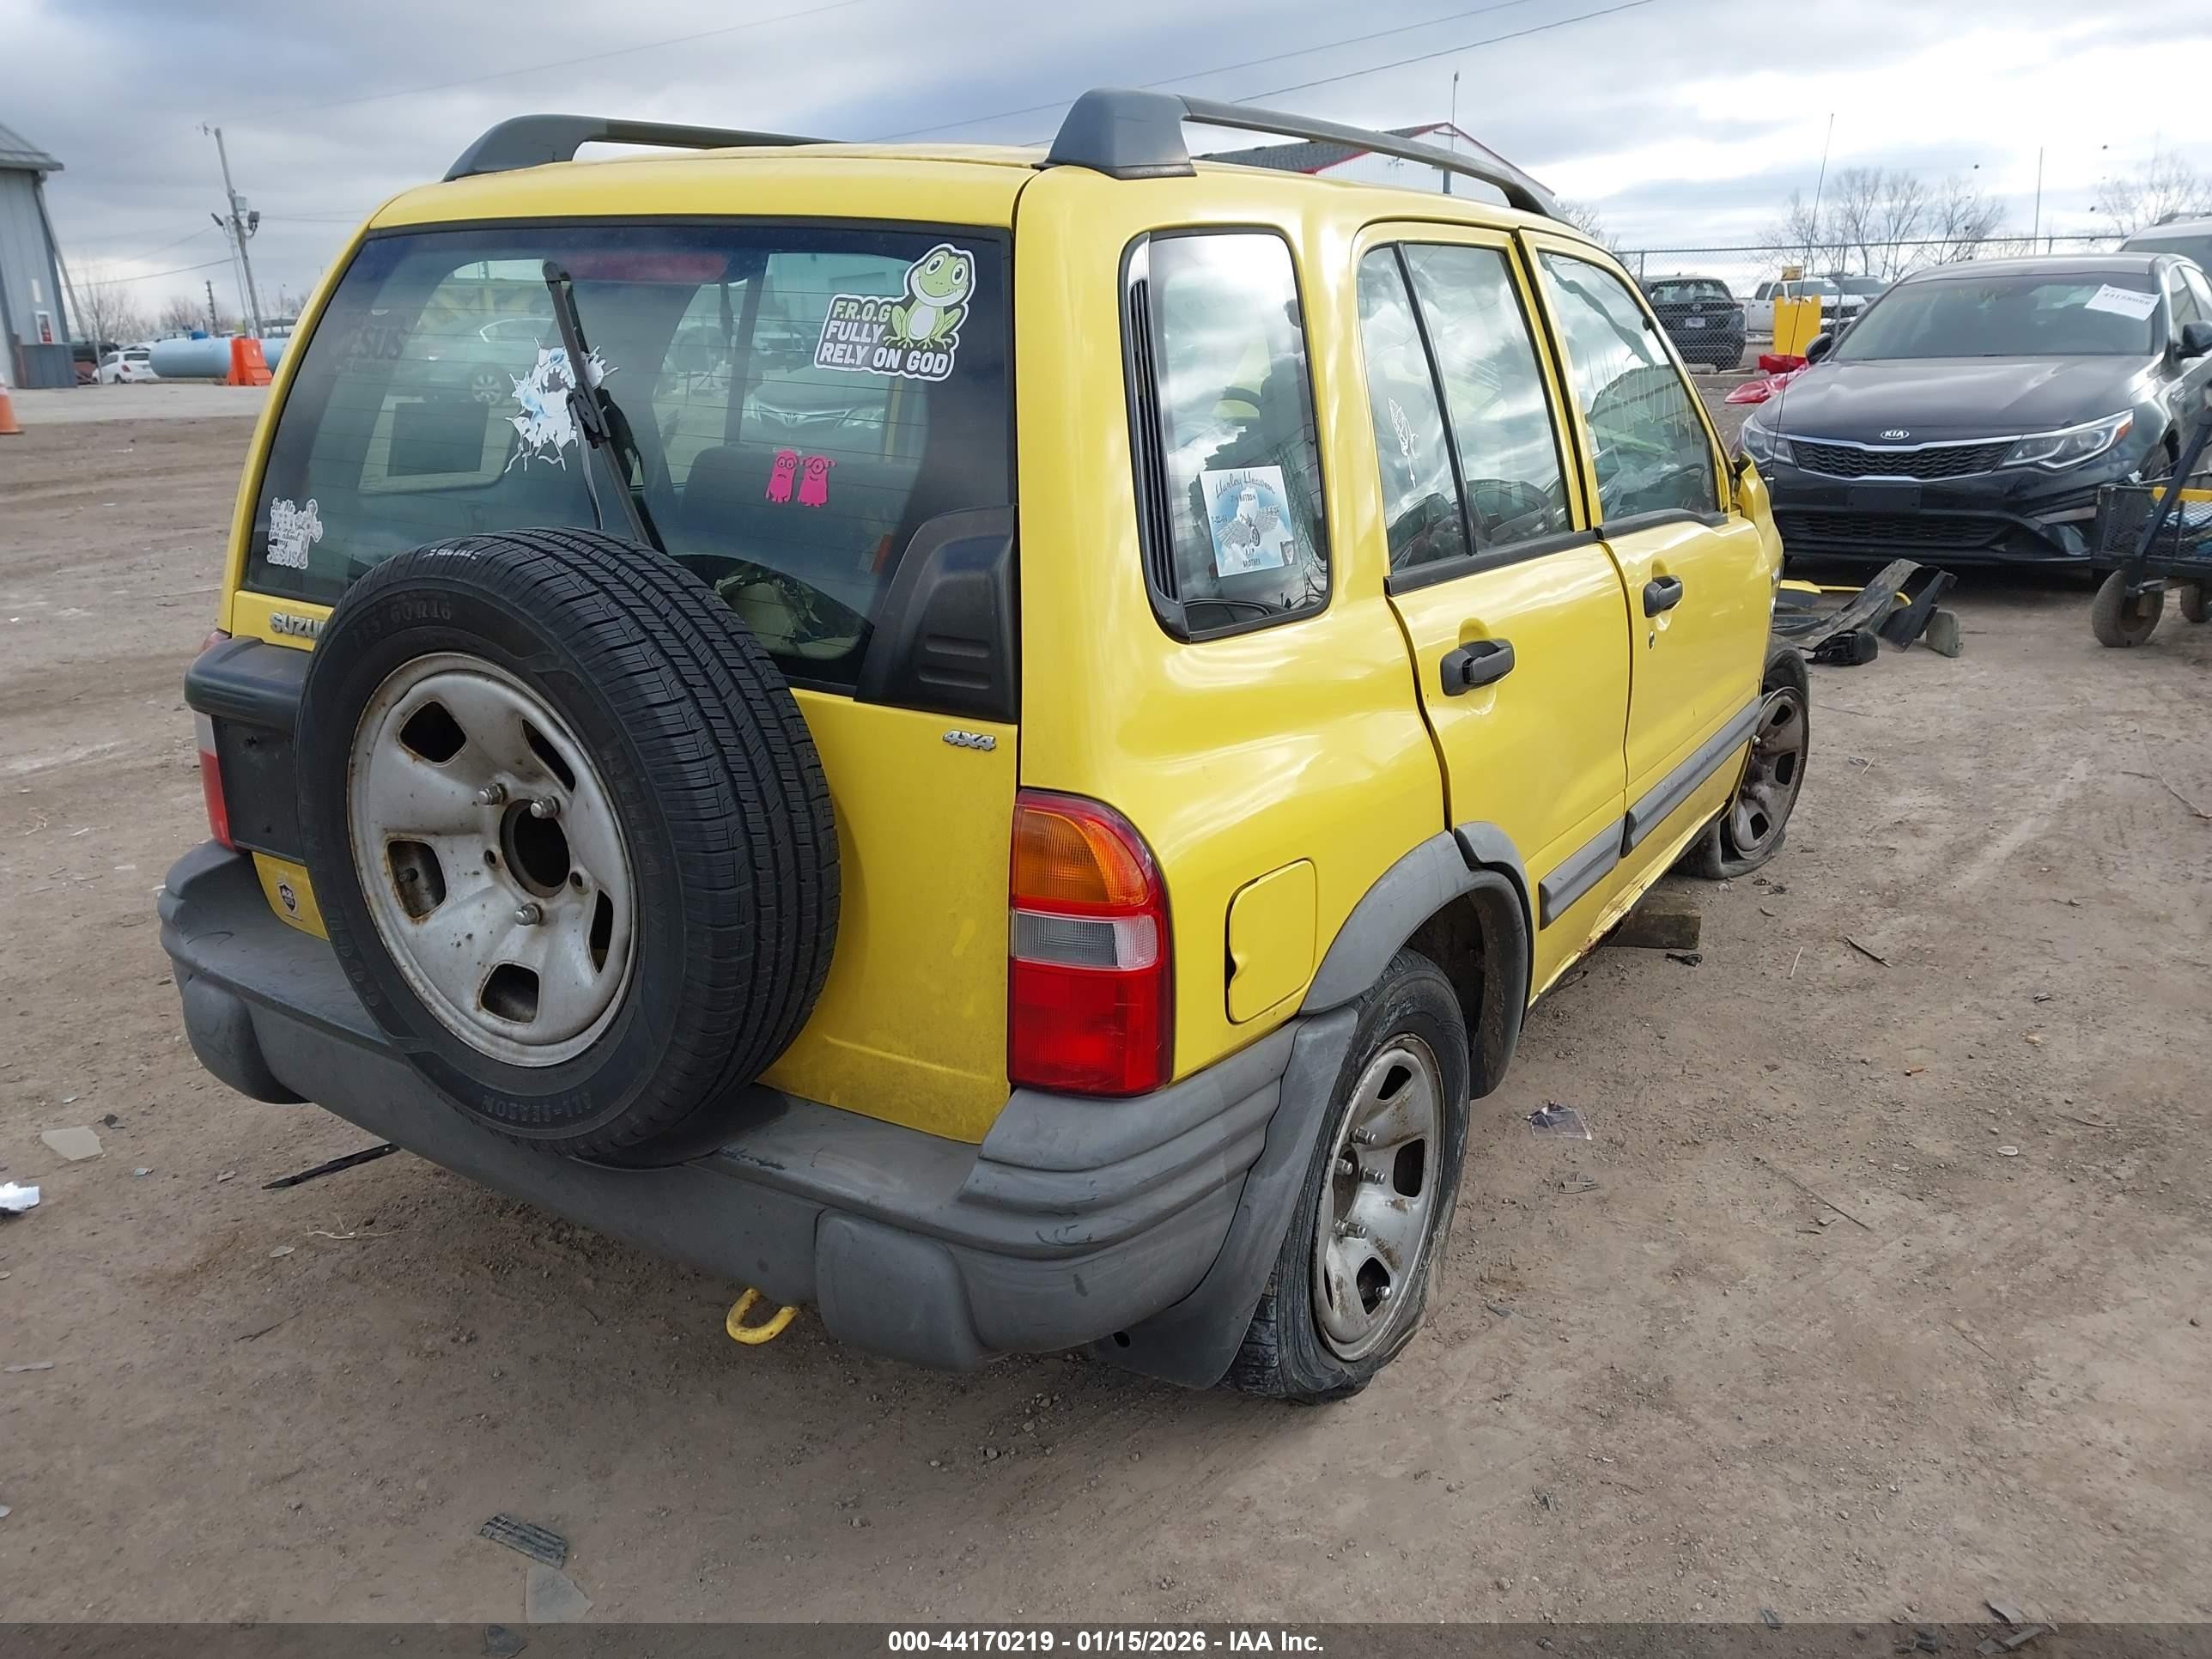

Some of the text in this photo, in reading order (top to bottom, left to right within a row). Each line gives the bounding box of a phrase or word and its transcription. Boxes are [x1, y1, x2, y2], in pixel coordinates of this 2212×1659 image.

[825, 320, 886, 343] FULLY
[819, 342, 949, 374] RELY ON GOD
[1884, 429, 1905, 438] KIA
[1216, 473, 1243, 501] Harley
[270, 611, 325, 638] SUZU
